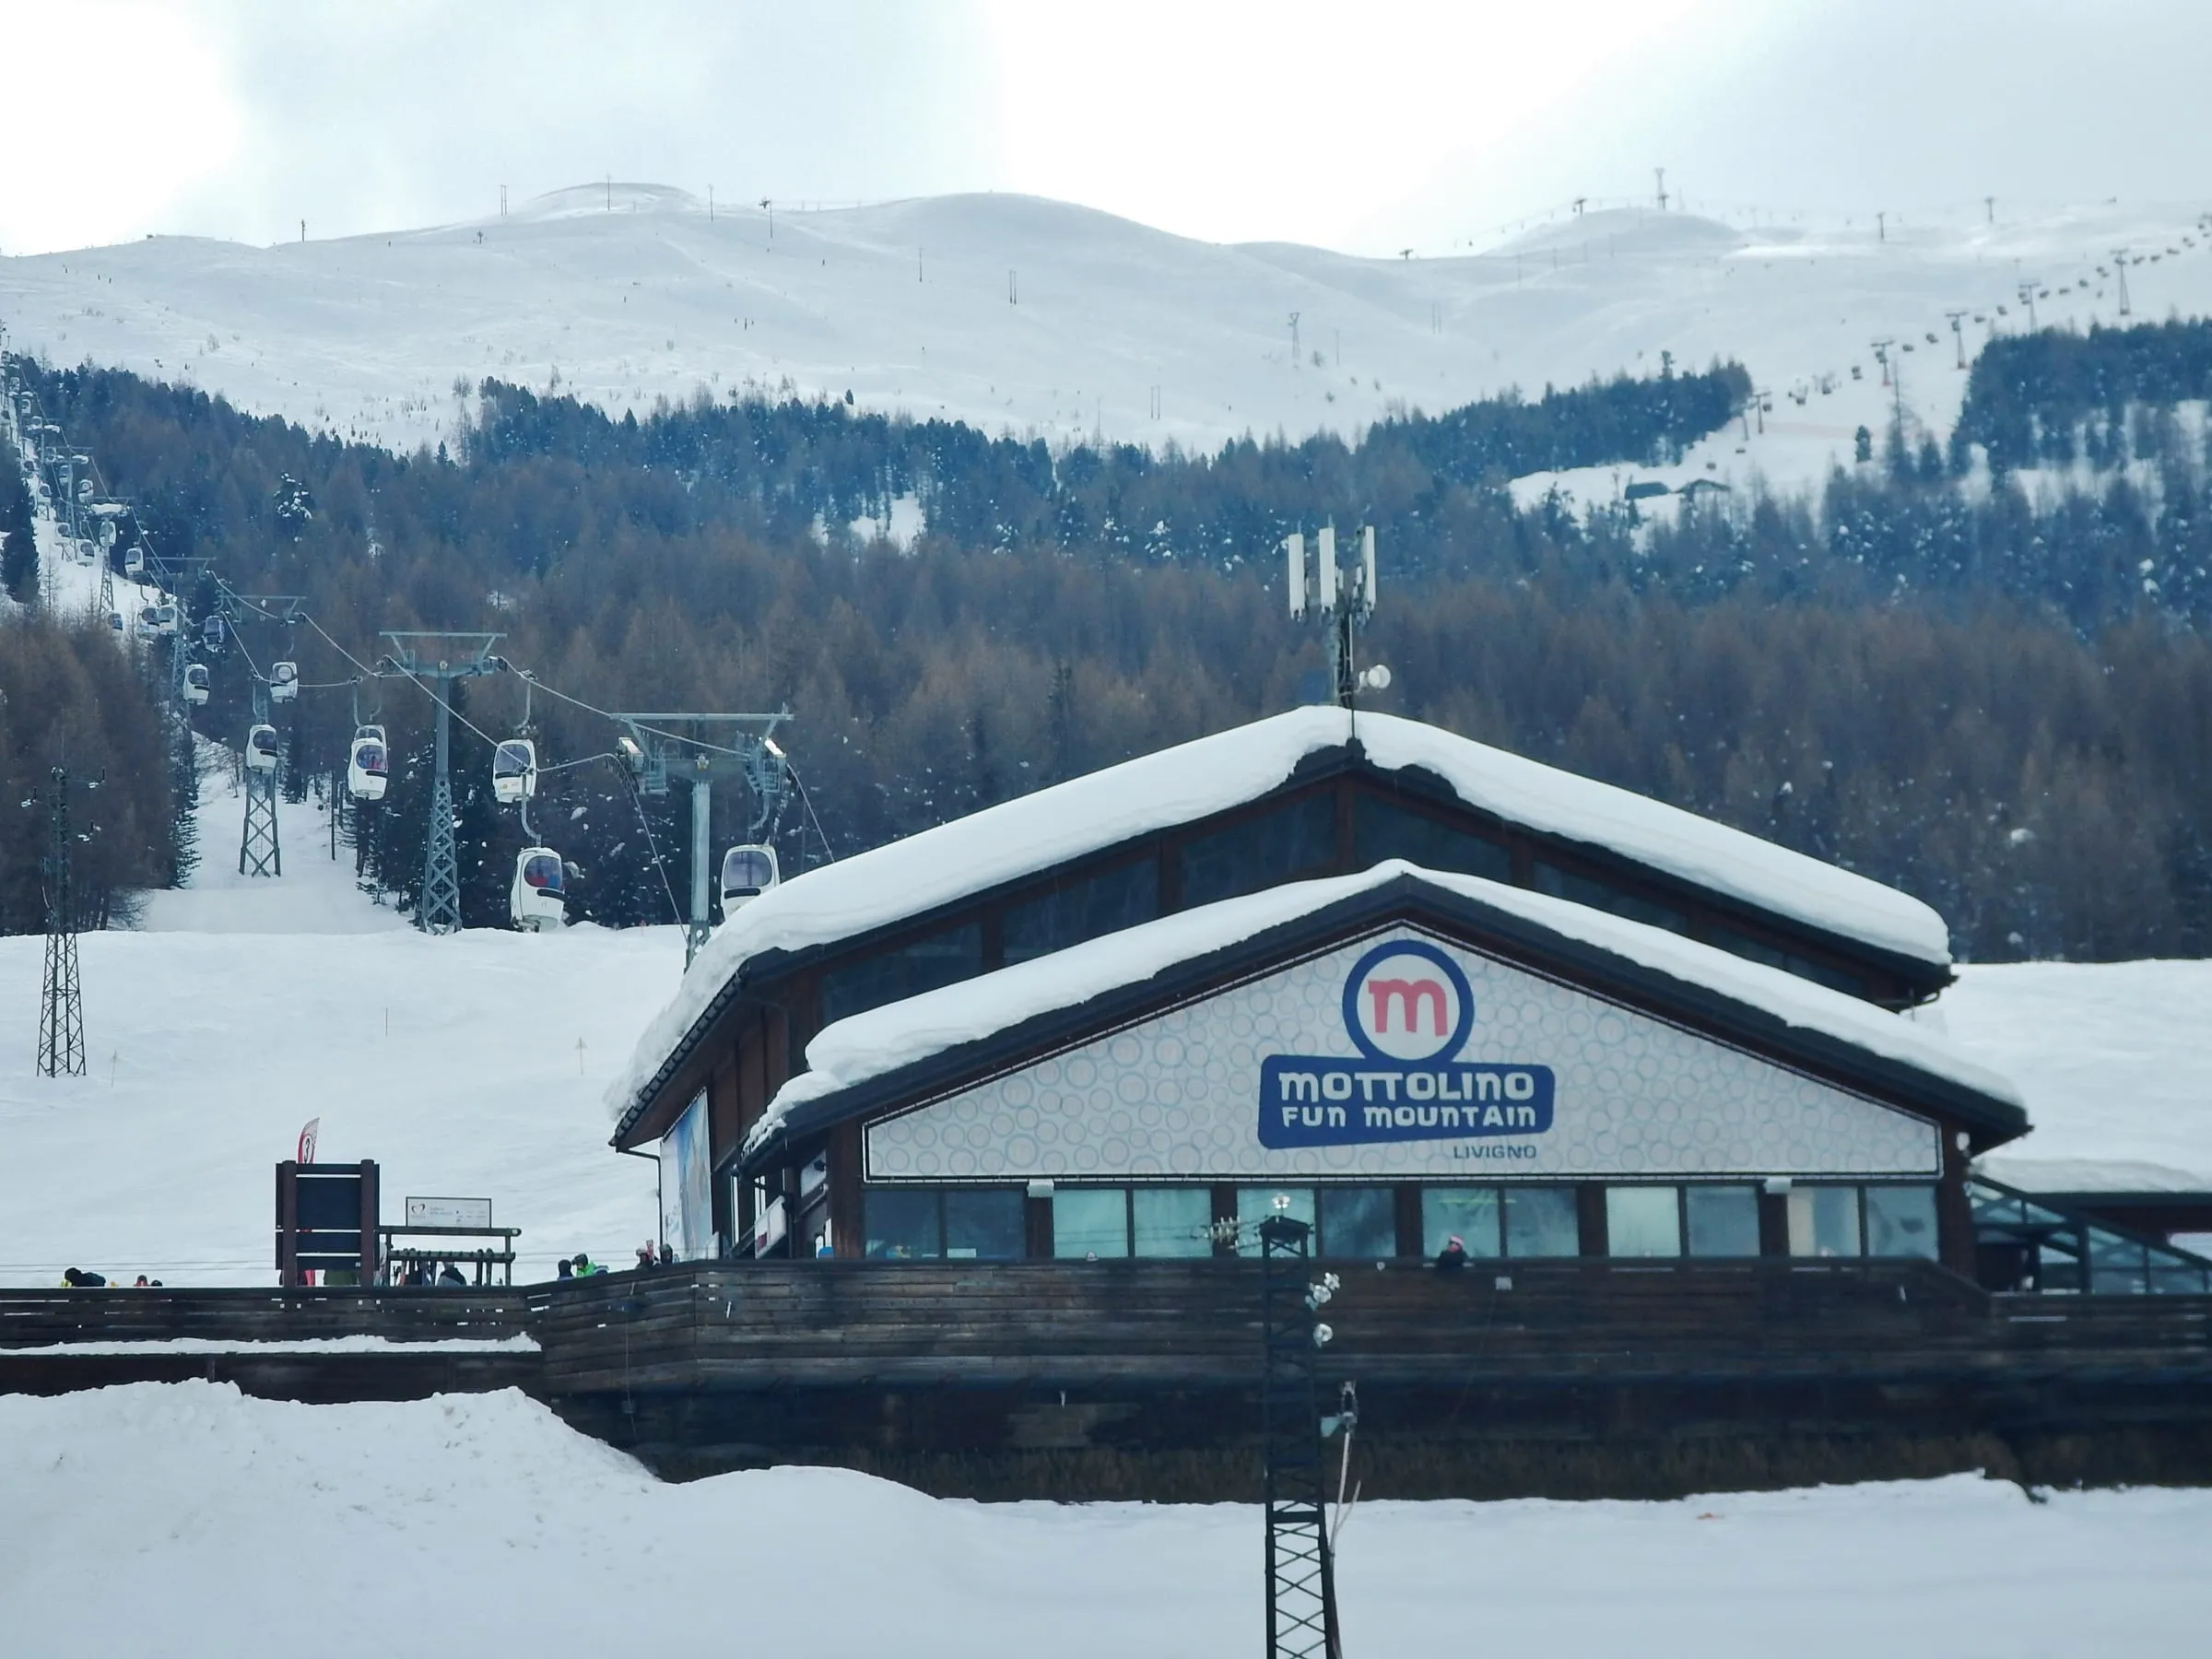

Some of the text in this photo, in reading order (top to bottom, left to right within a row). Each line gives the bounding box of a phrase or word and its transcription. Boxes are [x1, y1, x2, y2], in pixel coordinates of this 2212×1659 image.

[1278, 1072, 1535, 1103] MOTTOLINO
[1282, 1105, 1536, 1128] FUN MOUNTAIN
[1453, 1145, 1537, 1159] LIVIGNO
